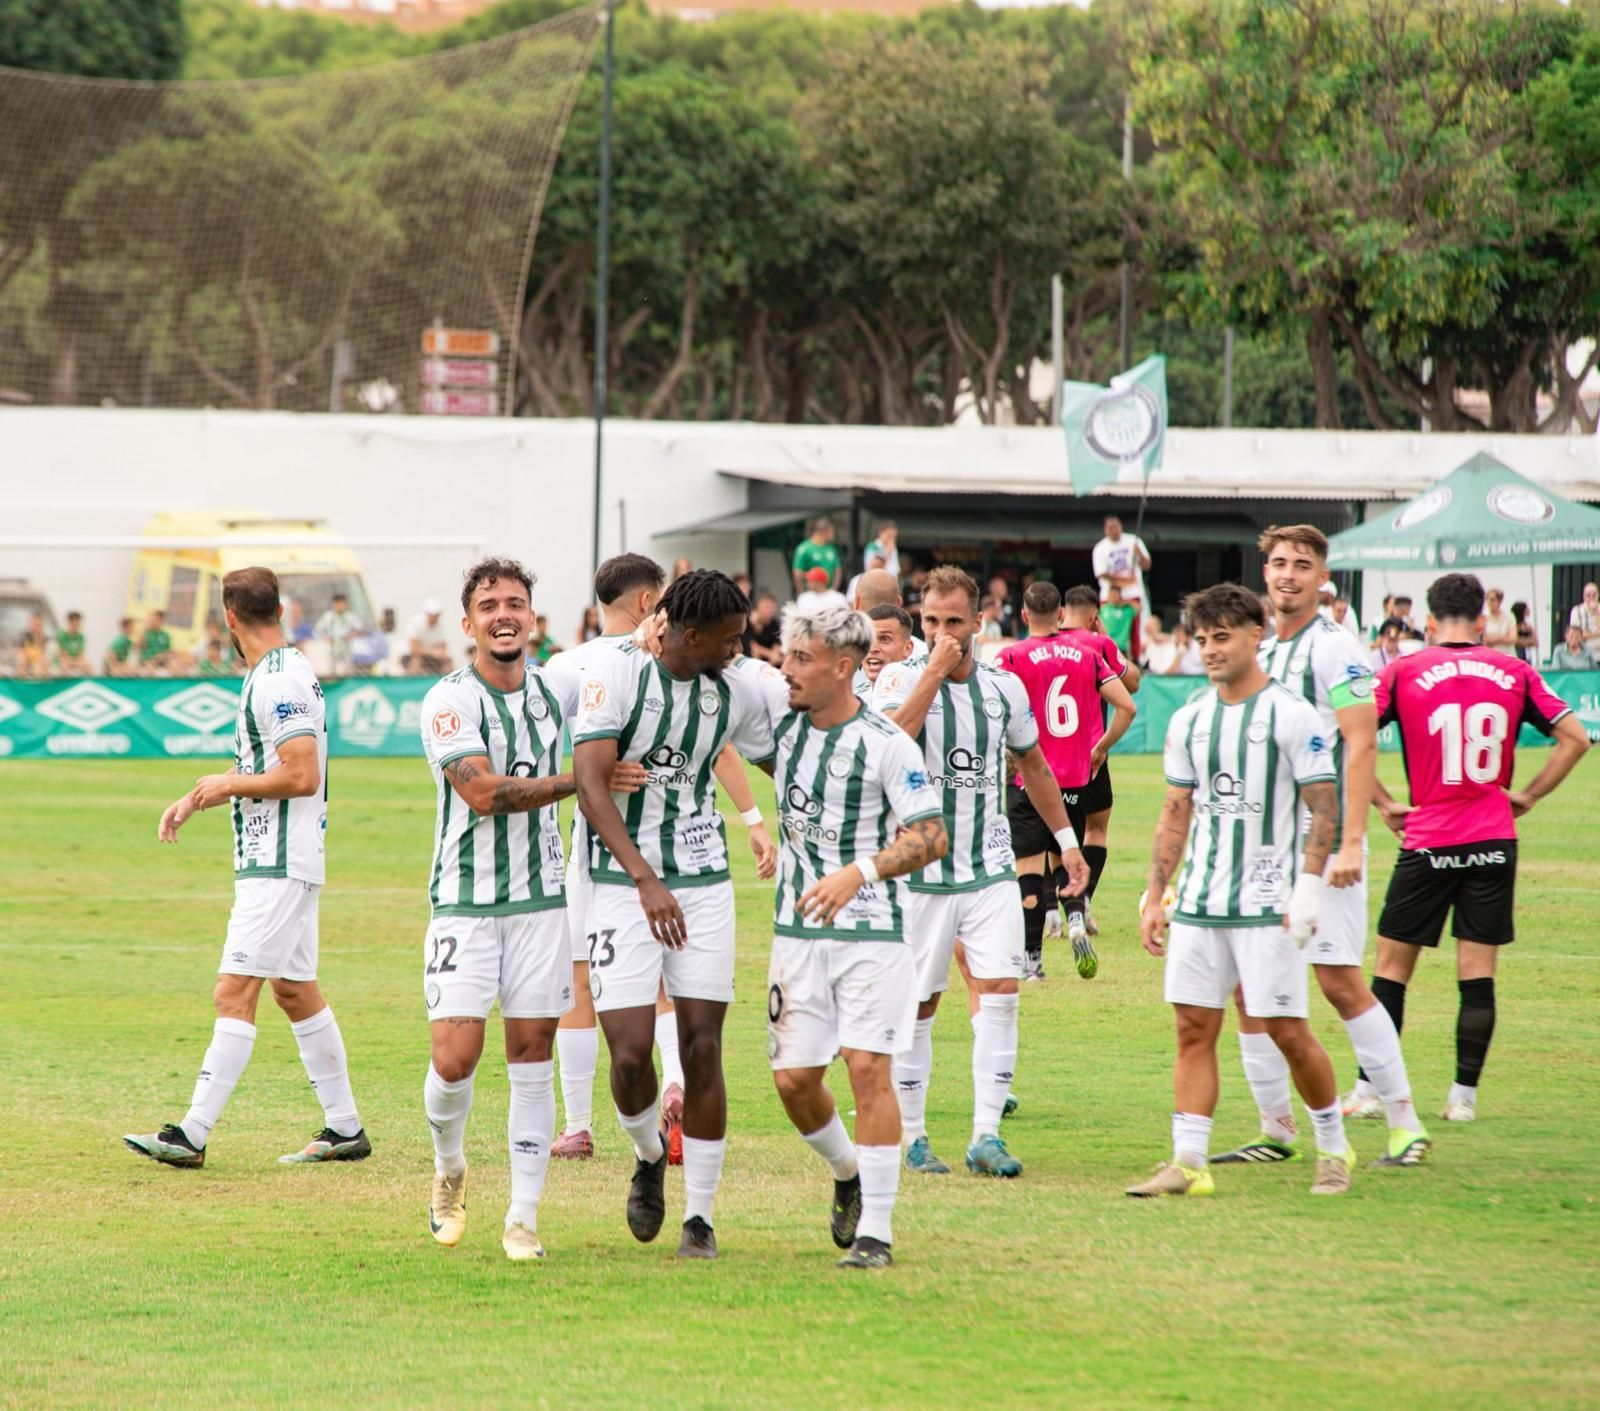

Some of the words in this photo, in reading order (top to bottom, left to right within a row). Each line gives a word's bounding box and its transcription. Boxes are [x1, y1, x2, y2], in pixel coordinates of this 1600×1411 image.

[1467, 543, 1530, 558] JUVENTUD
[1028, 648, 1051, 664] DEL
[1053, 646, 1082, 663] POZO
[1415, 661, 1458, 691] IAGO
[1046, 675, 1079, 738] 6
[1428, 702, 1509, 785] 18
[1429, 850, 1507, 869] VALANS
[426, 936, 458, 976] 22
